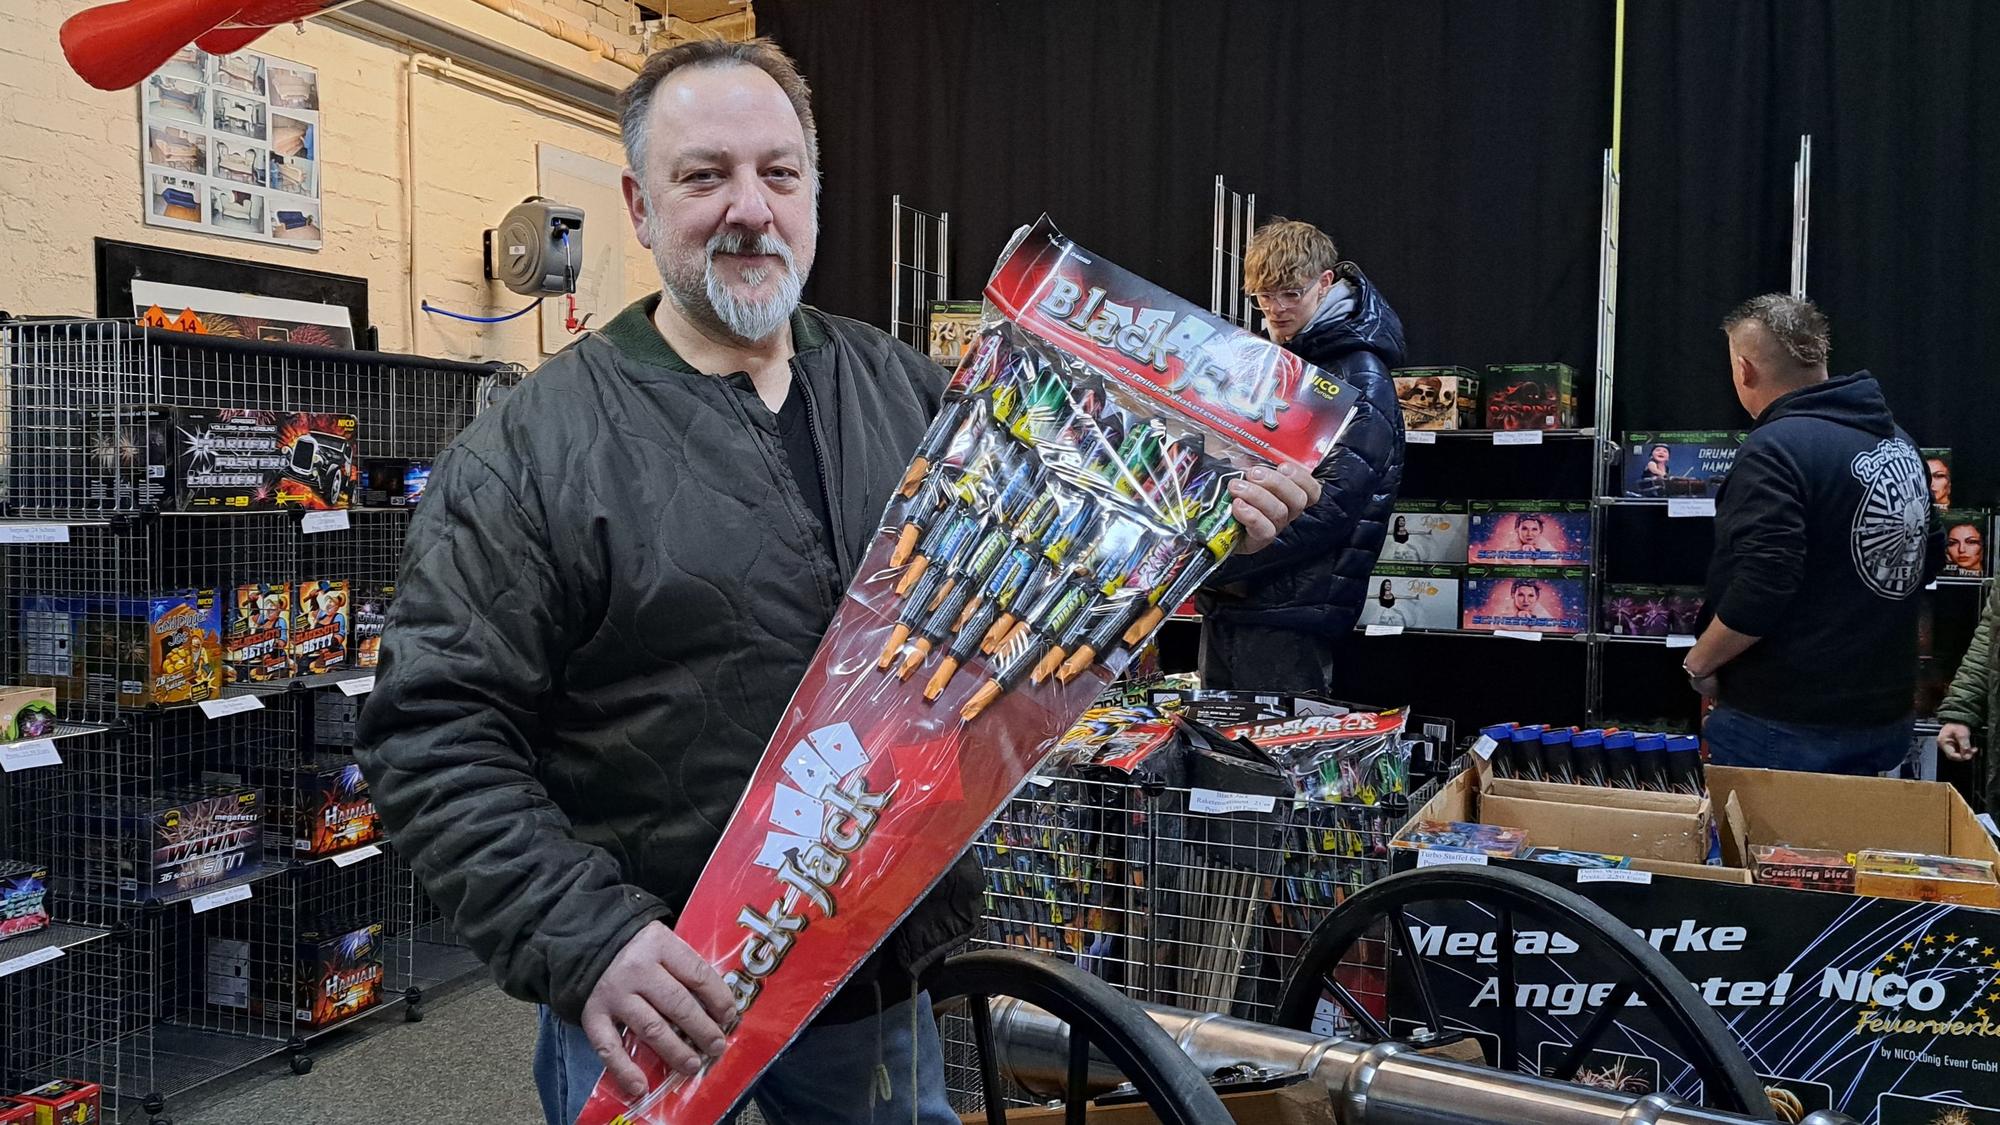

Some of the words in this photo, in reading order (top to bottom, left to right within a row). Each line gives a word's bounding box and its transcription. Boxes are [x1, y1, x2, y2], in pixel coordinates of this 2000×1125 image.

[1038, 275, 1179, 373] Black
[1172, 393, 1272, 450] Raketensortiment
[241, 638, 276, 661] BETTY
[302, 632, 334, 655] BETTY
[167, 831, 242, 864] WAHN
[779, 776, 887, 919] Jack
[1761, 866, 1820, 881] Crackling
[1823, 868, 1849, 880] bird
[1398, 919, 1748, 964] Megasrke
[1469, 972, 1794, 1016] Angete!
[1818, 967, 1946, 1012] NICO
[1881, 1046, 1891, 1059] by
[1944, 1055, 1969, 1069] Event
[1971, 1059, 1999, 1073] GmbH
